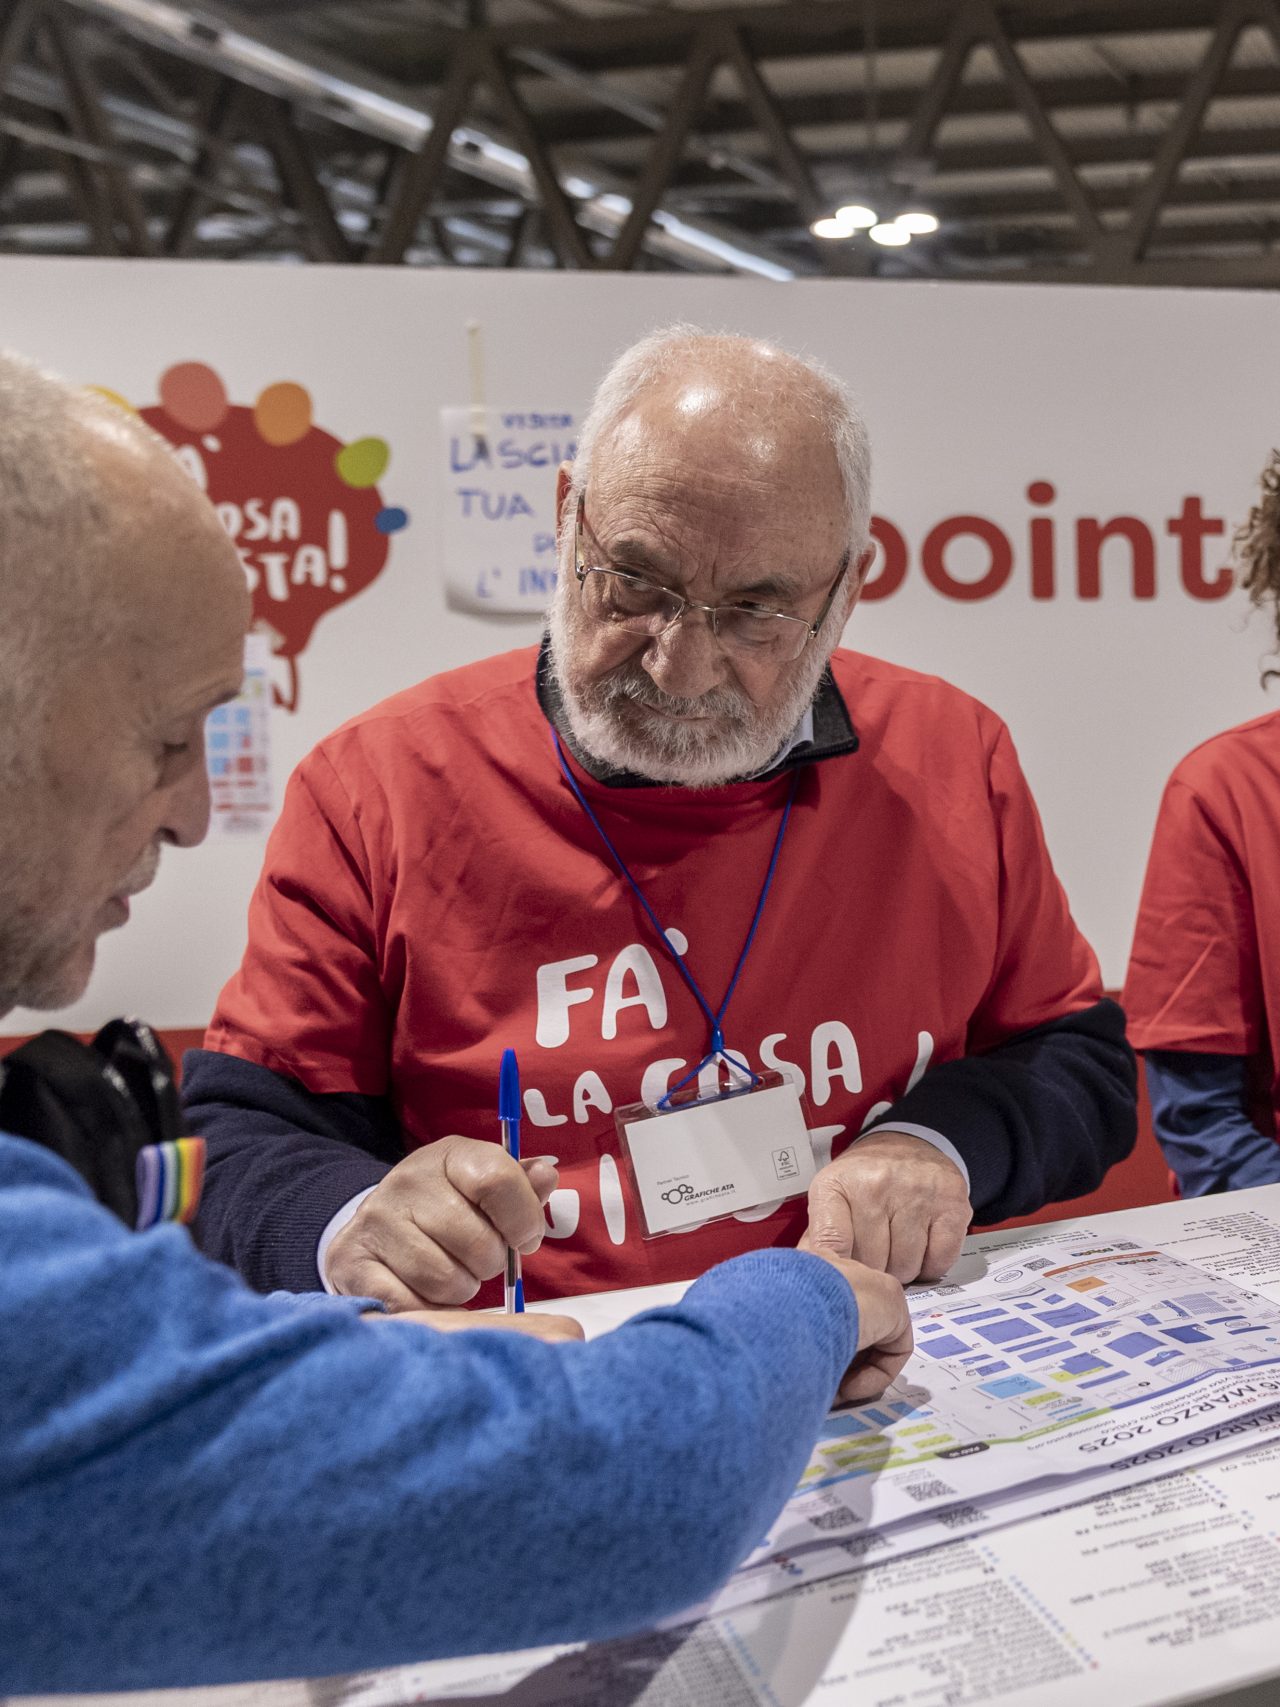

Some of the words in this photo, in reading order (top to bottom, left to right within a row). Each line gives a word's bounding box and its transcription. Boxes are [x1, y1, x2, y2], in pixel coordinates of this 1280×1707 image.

[214, 498, 300, 542] OSA
[458, 486, 534, 520] TUA
[523, 1070, 613, 1128] LA
[684, 1185, 719, 1202] GRAFICHE
[720, 1183, 735, 1192] ATA
[1157, 1384, 1256, 1426] MARZO
[1078, 1425, 1153, 1453] 2025
[1109, 1444, 1184, 1472] 2025
